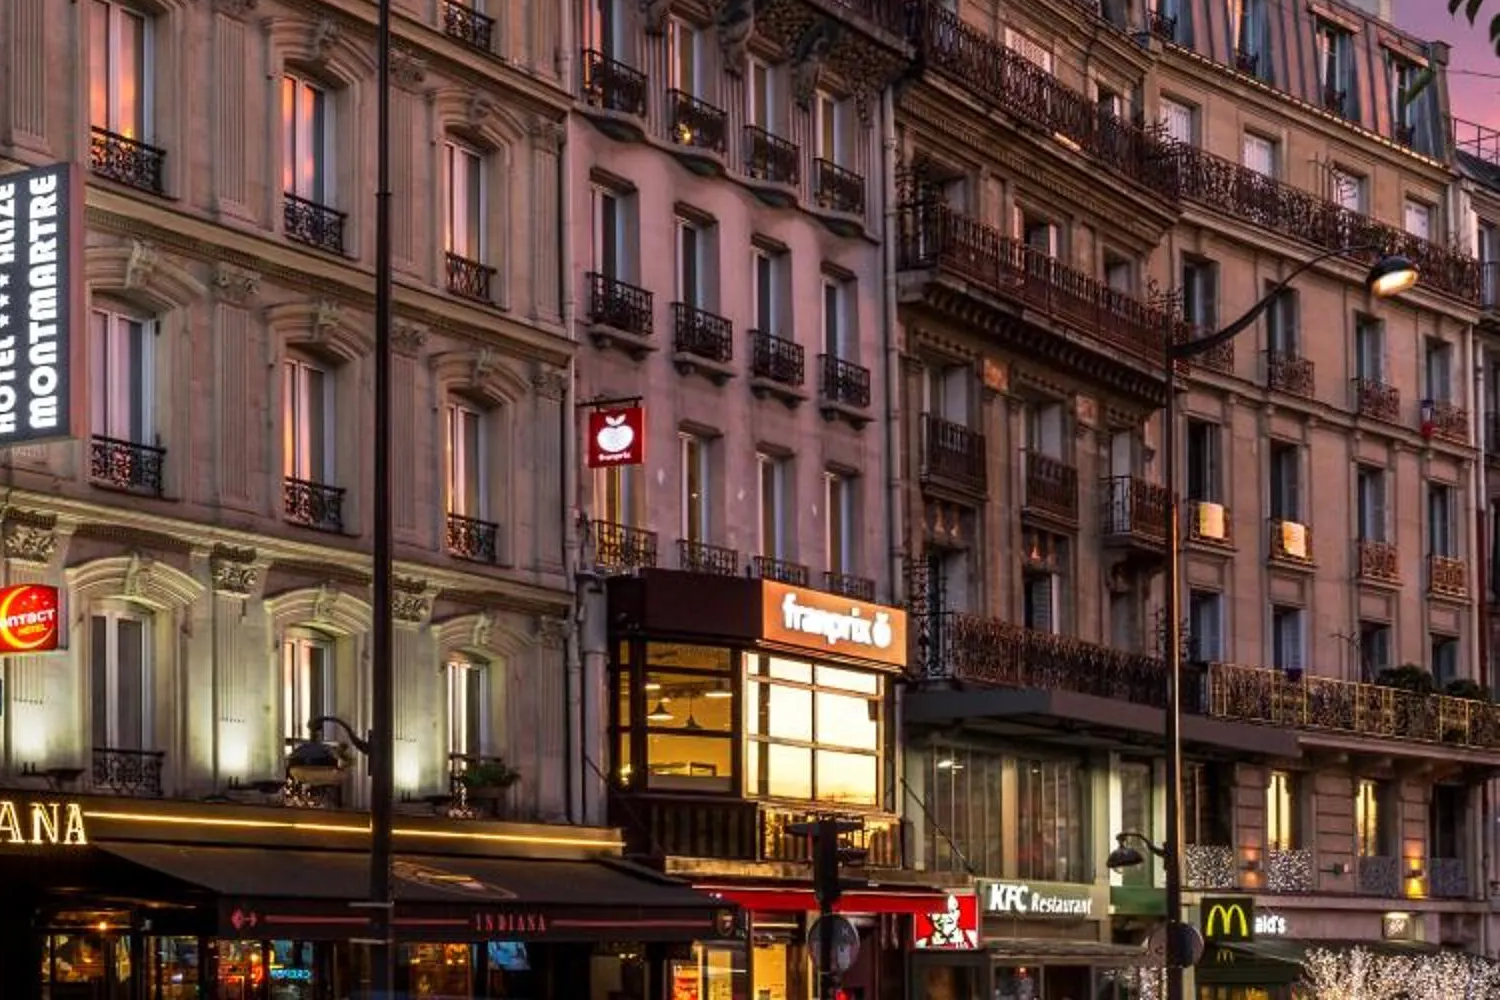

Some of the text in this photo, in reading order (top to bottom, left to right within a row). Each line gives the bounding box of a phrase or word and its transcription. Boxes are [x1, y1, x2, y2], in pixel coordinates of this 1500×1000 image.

[29, 174, 58, 429] MONTMARTRE
[989, 883, 1093, 915] KFC Restaurant
[476, 912, 546, 932] INDIANA
